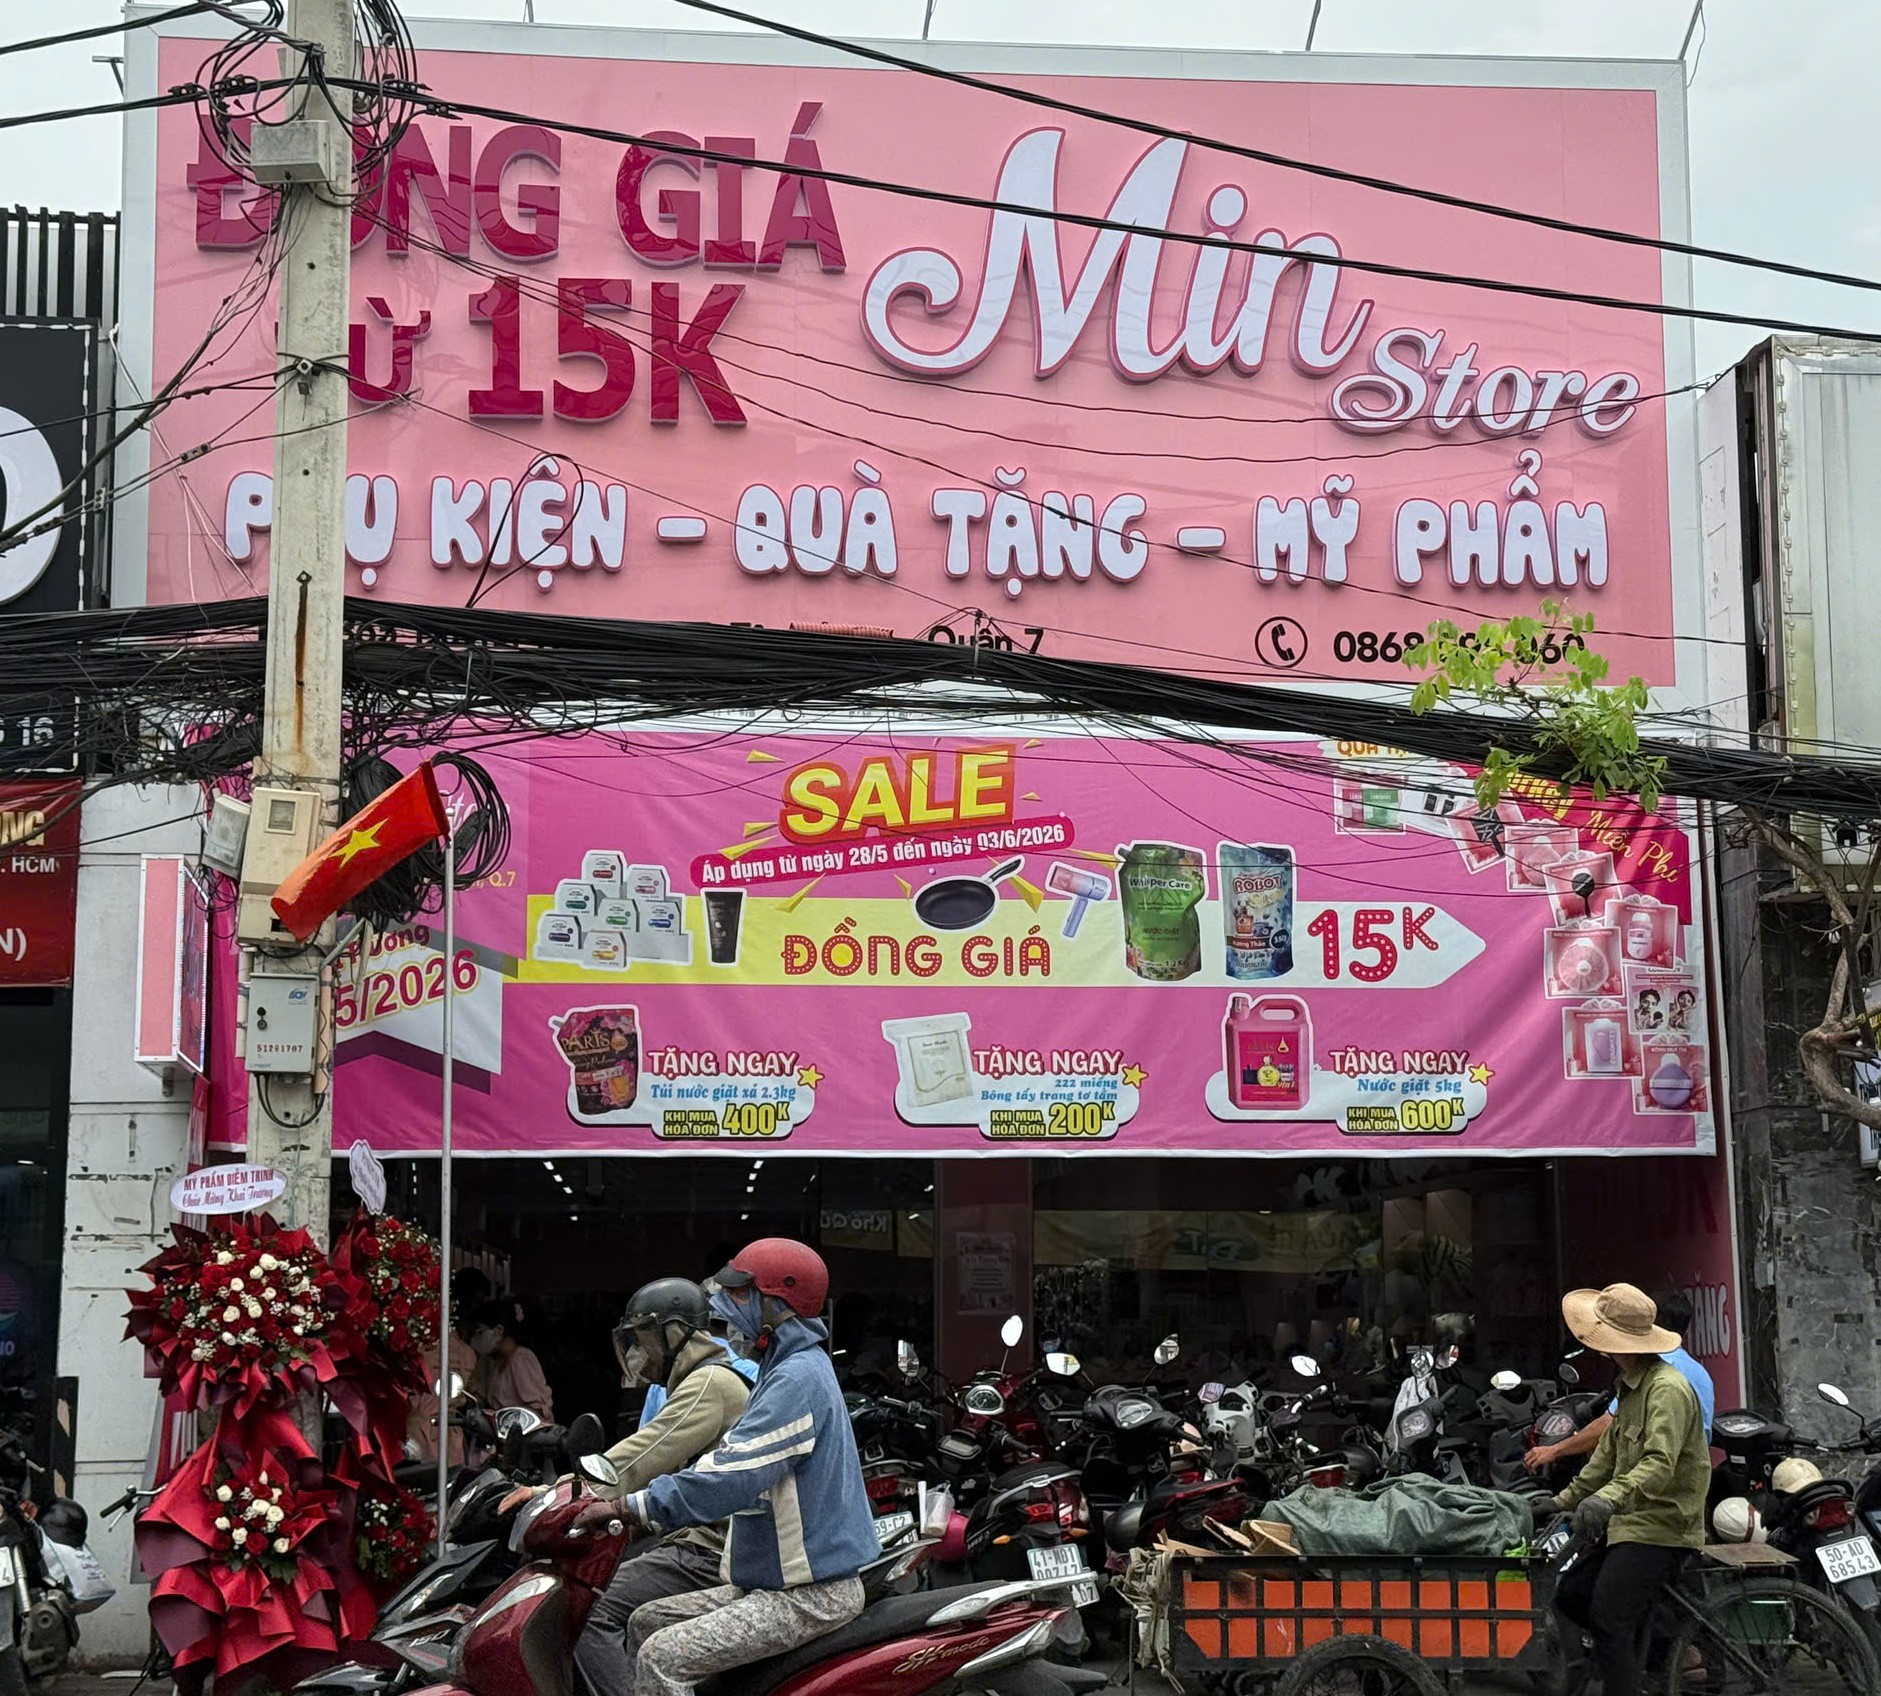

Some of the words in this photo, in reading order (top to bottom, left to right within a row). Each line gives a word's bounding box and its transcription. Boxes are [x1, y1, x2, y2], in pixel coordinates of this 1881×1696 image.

[186, 113, 563, 264] ĐNG
[615, 102, 846, 272] GIÁ
[860, 125, 1375, 382] Min
[276, 297, 432, 403] Ừ
[467, 277, 748, 427] 15K
[1331, 326, 1642, 437] Store
[223, 470, 399, 590] PỤ
[430, 454, 628, 593] KIỆN
[733, 459, 898, 578] QUÀ
[930, 464, 1148, 599] TẶNG
[1252, 474, 1360, 587] MỸ
[1392, 449, 1609, 588] PHẨM
[782, 748, 1011, 837] SALE
[702, 860, 726, 884] Áp
[730, 859, 775, 883] dụng
[778, 855, 797, 875] từ
[801, 850, 844, 873] ngày
[849, 844, 888, 867] 28/5
[893, 837, 926, 861] đến
[930, 836, 972, 858] ngày
[977, 824, 1066, 851] 03/6/2026
[488, 871, 516, 887] Q.7
[1169, 880, 1191, 889] Care
[1233, 877, 1282, 894] ROBOT
[780, 917, 944, 978] ĐỒNG
[961, 925, 1052, 977] GIÁ
[1307, 907, 1439, 982] 15K
[561, 1032, 610, 1051] PARIS
[648, 1046, 718, 1080] TẶNG
[727, 1051, 797, 1076] NGAY
[973, 1045, 1045, 1079] TẶNG
[1050, 1050, 1123, 1075] NGAY
[1329, 1045, 1397, 1078] TẶNG
[1402, 1050, 1470, 1075] NGAY
[650, 1084, 672, 1099] Túi
[677, 1084, 708, 1099] nước
[712, 1084, 738, 1103] giặt
[742, 1083, 757, 1099] xả
[761, 1084, 796, 1102] 2.3kg
[981, 1090, 1012, 1102] Bông
[1040, 1091, 1074, 1102] trang
[1055, 1079, 1076, 1088] 222
[1080, 1076, 1118, 1090] miếng
[1357, 1078, 1396, 1092] Nước
[1401, 1078, 1430, 1096] giặt
[1435, 1079, 1462, 1094] 5kg
[664, 1111, 686, 1123] KHI
[688, 1111, 718, 1123] MUA
[664, 1123, 690, 1136] HÓA
[692, 1123, 719, 1136] ĐƠN
[723, 1101, 790, 1136] 400K
[991, 1110, 1012, 1122] KHI
[1015, 1110, 1043, 1122] MUA
[991, 1122, 1016, 1135] HÓA
[1019, 1122, 1046, 1135] ĐƠN
[1049, 1101, 1115, 1136] 200K
[1348, 1107, 1367, 1119] KHI
[1370, 1107, 1396, 1119] MUA
[1348, 1118, 1371, 1131] HÓA
[1374, 1118, 1399, 1131] ĐƠN
[1400, 1098, 1465, 1131] 600K
